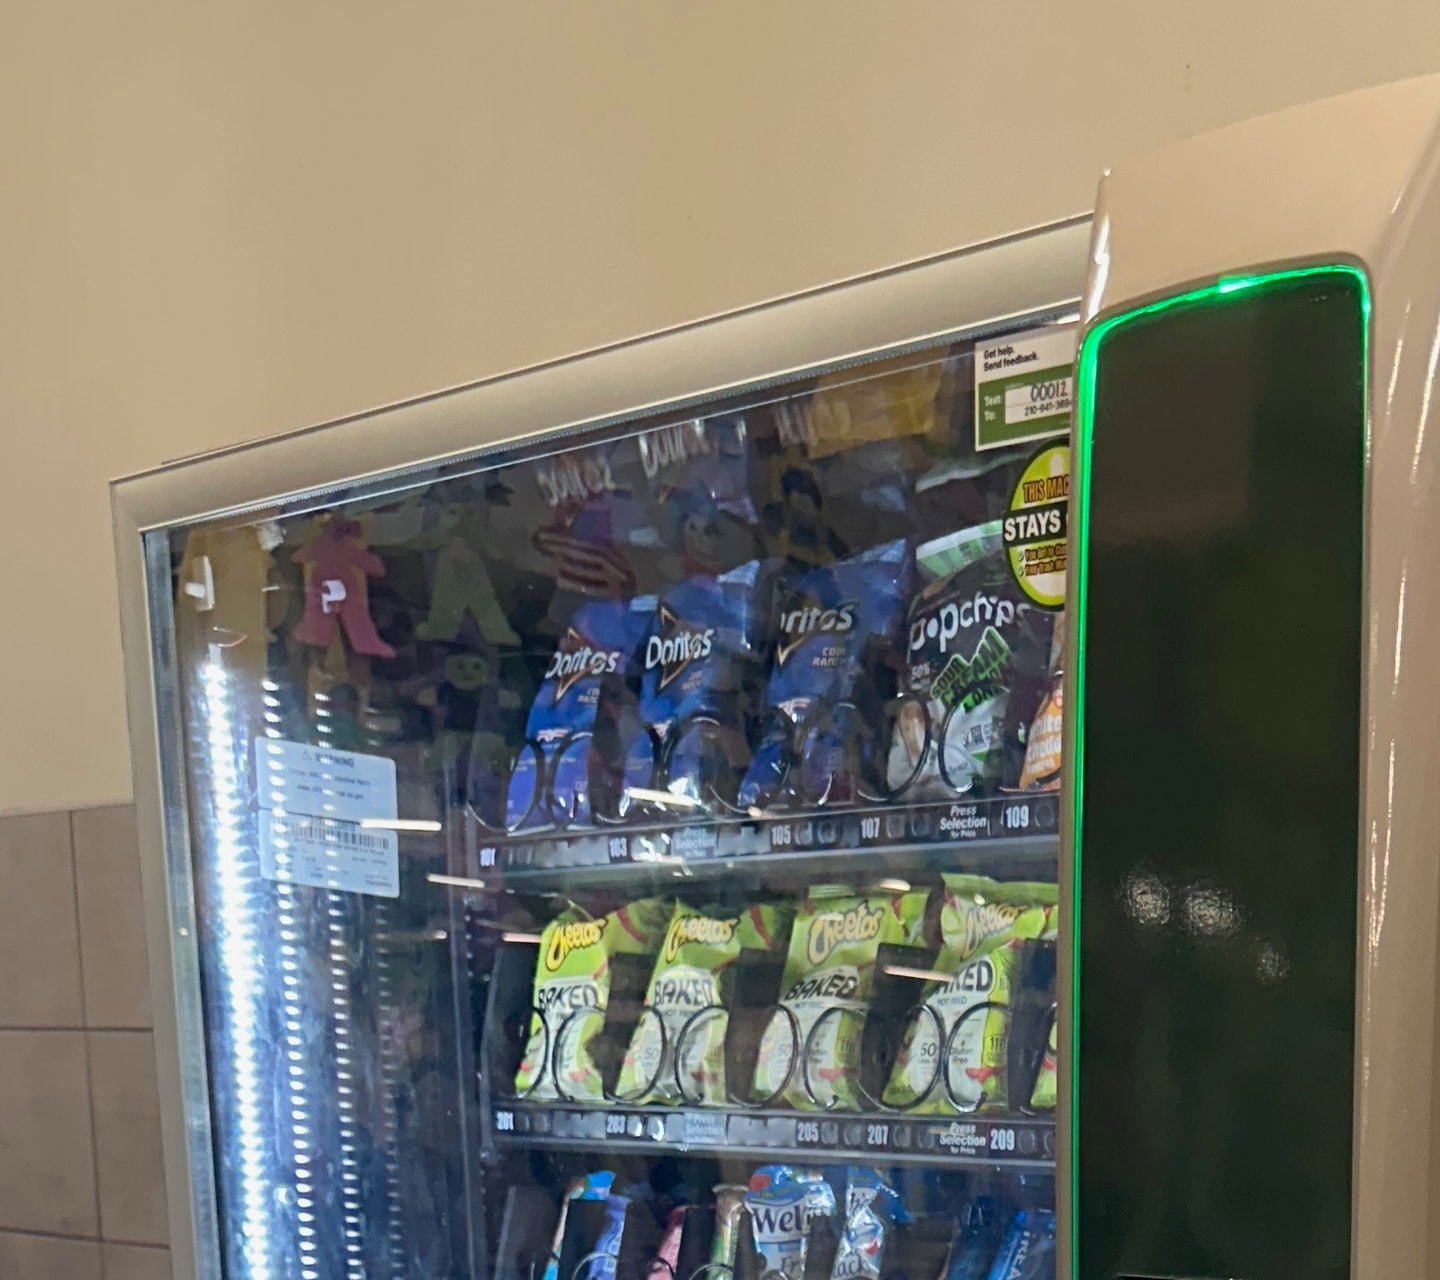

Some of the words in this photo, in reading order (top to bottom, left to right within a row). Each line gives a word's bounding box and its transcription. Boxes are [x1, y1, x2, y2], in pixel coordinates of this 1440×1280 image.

[1023, 479, 1046, 503] THIS
[1004, 509, 1061, 541] STAYS
[645, 629, 715, 670] Doritos
[951, 805, 976, 817] Press
[1006, 805, 1029, 827] 109
[861, 818, 880, 838] 107
[940, 816, 986, 831] Selection
[771, 826, 791, 845] 105
[609, 838, 627, 856] 103
[808, 901, 885, 965] Cheetos
[496, 1112, 514, 1130] 201
[797, 1123, 819, 1142] 205
[868, 1126, 888, 1145] 207
[940, 1133, 986, 1147] Selection
[990, 1129, 1015, 1150] 209
